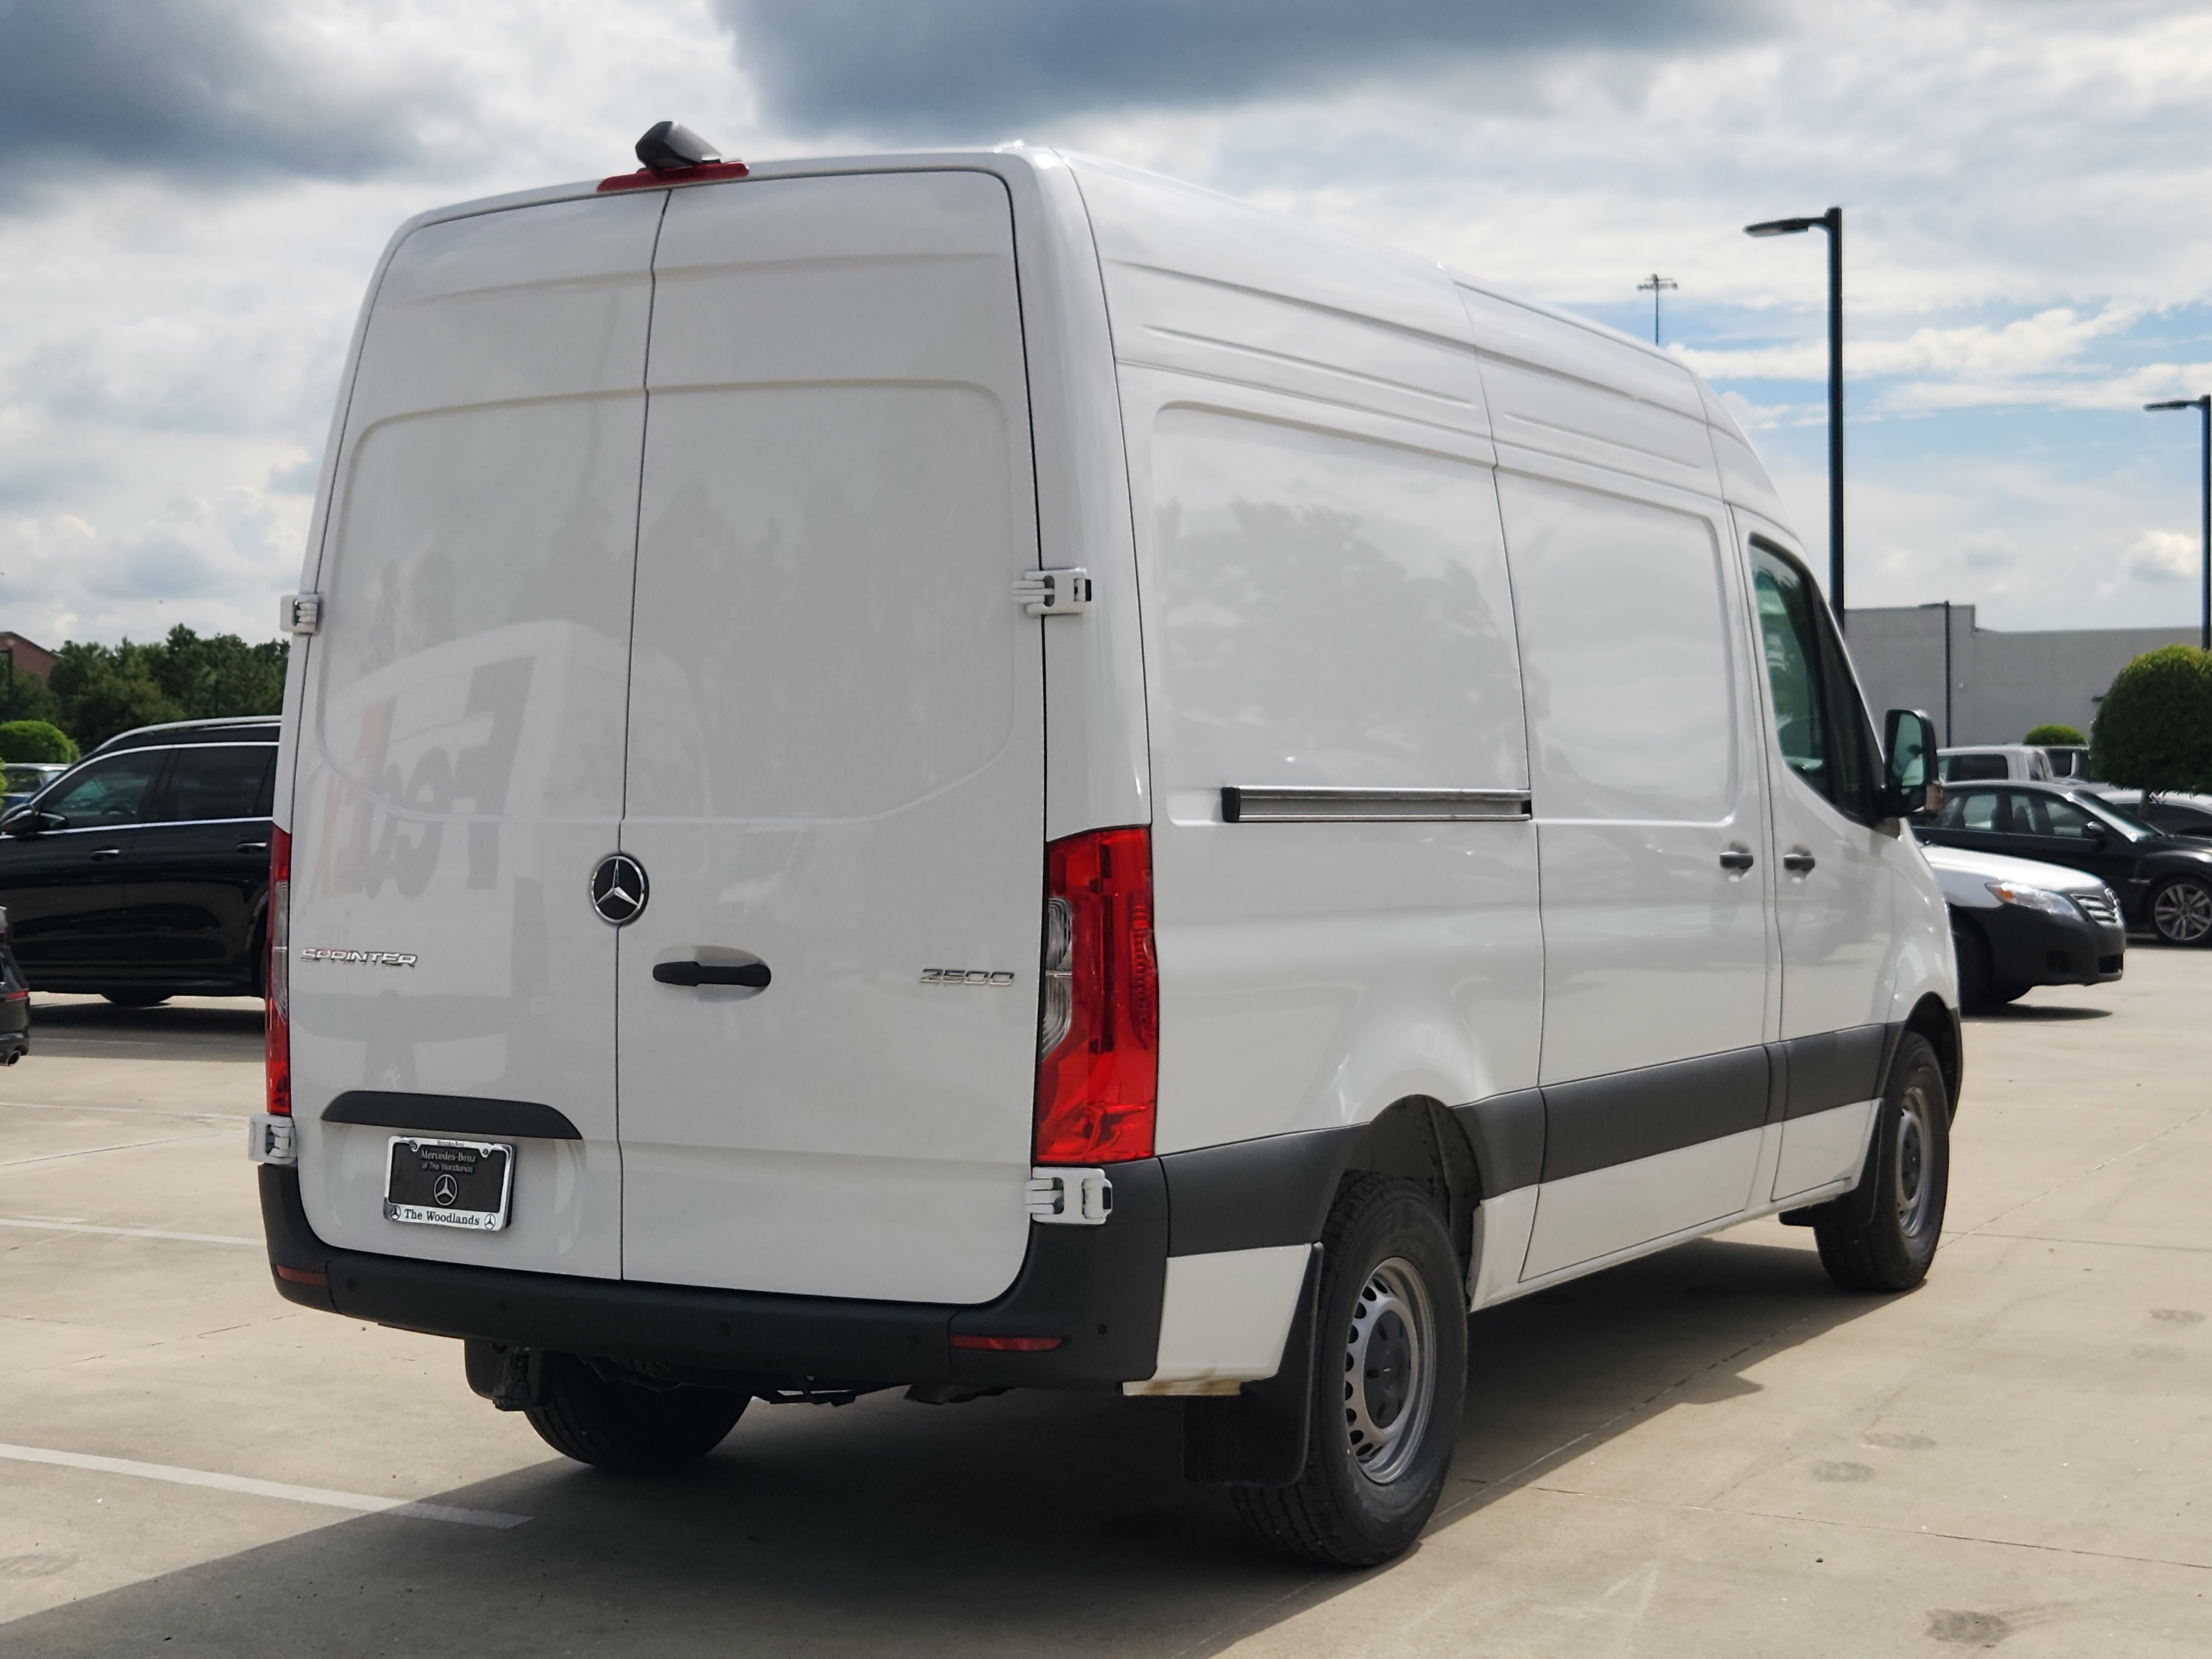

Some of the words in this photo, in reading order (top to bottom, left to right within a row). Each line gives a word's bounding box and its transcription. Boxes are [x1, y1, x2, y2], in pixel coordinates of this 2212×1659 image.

[300, 947, 417, 966] SPRINTER
[921, 969, 1015, 985] 2500
[421, 1150, 476, 1162] Mercedes-Benz
[404, 1209, 422, 1220] The
[426, 1210, 480, 1226] Woodlands
